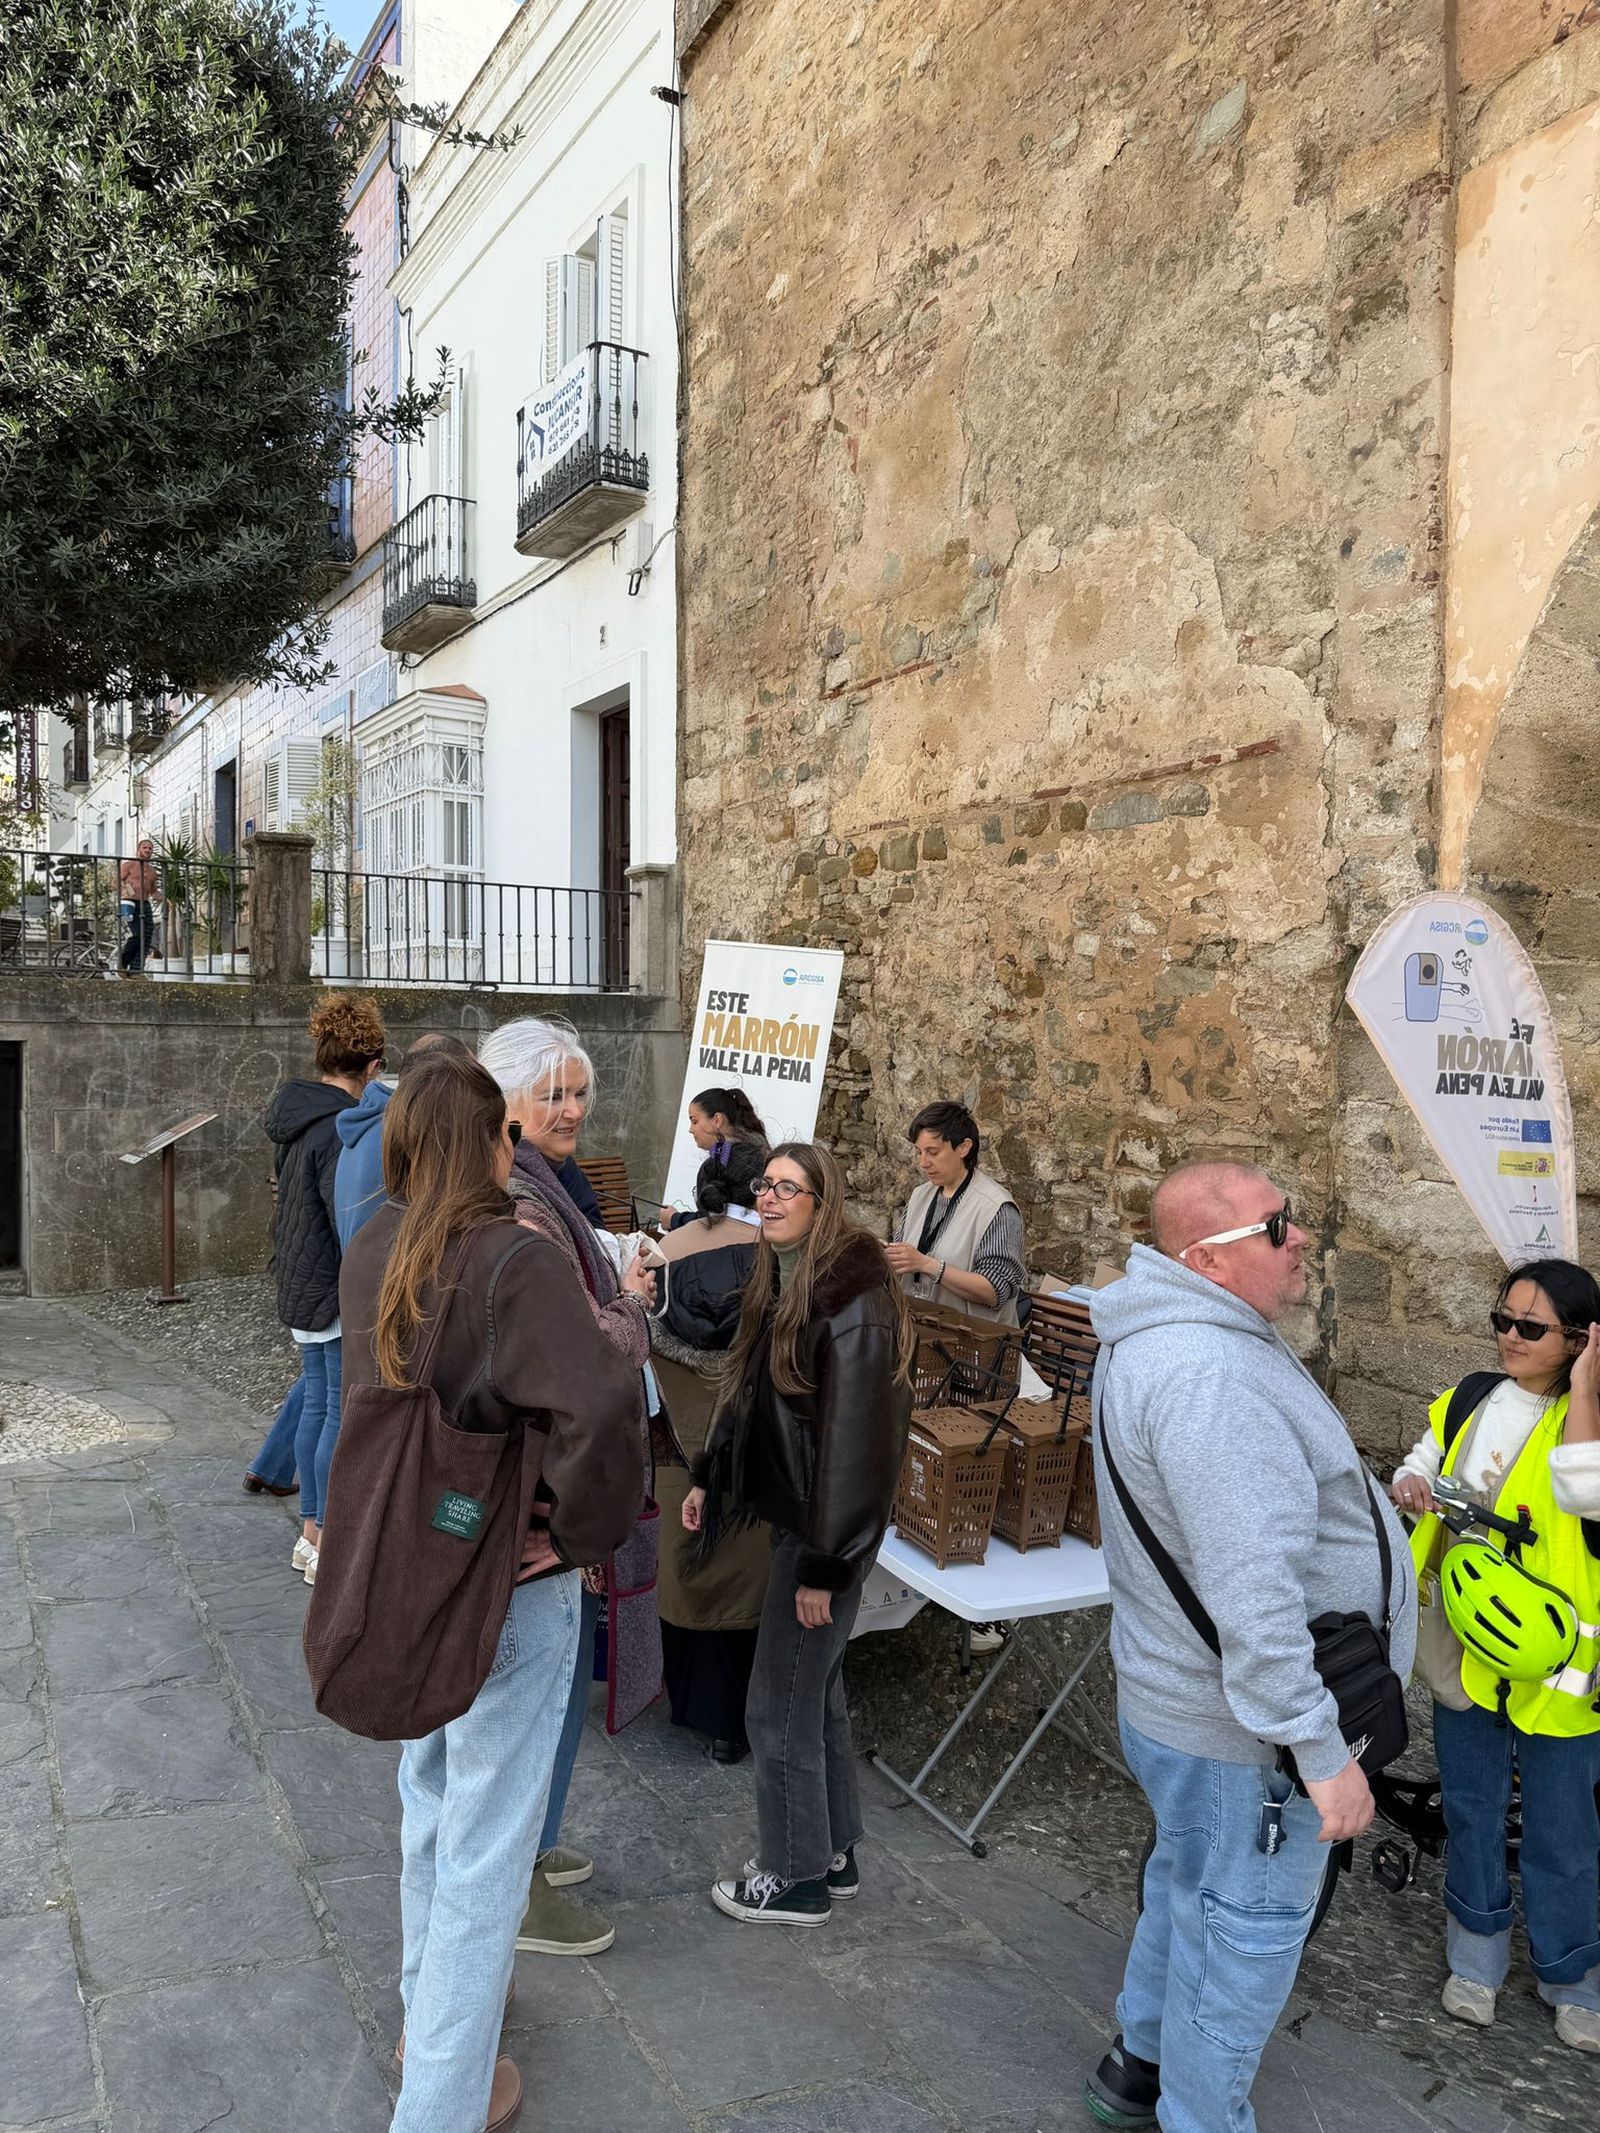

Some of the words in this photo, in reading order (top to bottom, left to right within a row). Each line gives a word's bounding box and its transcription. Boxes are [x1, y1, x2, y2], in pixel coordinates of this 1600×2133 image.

[706, 990, 750, 1014] ESTE
[701, 1012, 820, 1060] MARRÓN
[700, 1048, 739, 1072] VALE
[742, 1053, 763, 1077] LA
[766, 1057, 811, 1083] PENA
[447, 1509, 471, 1523] SHARE
[452, 1497, 478, 1511] LIVING
